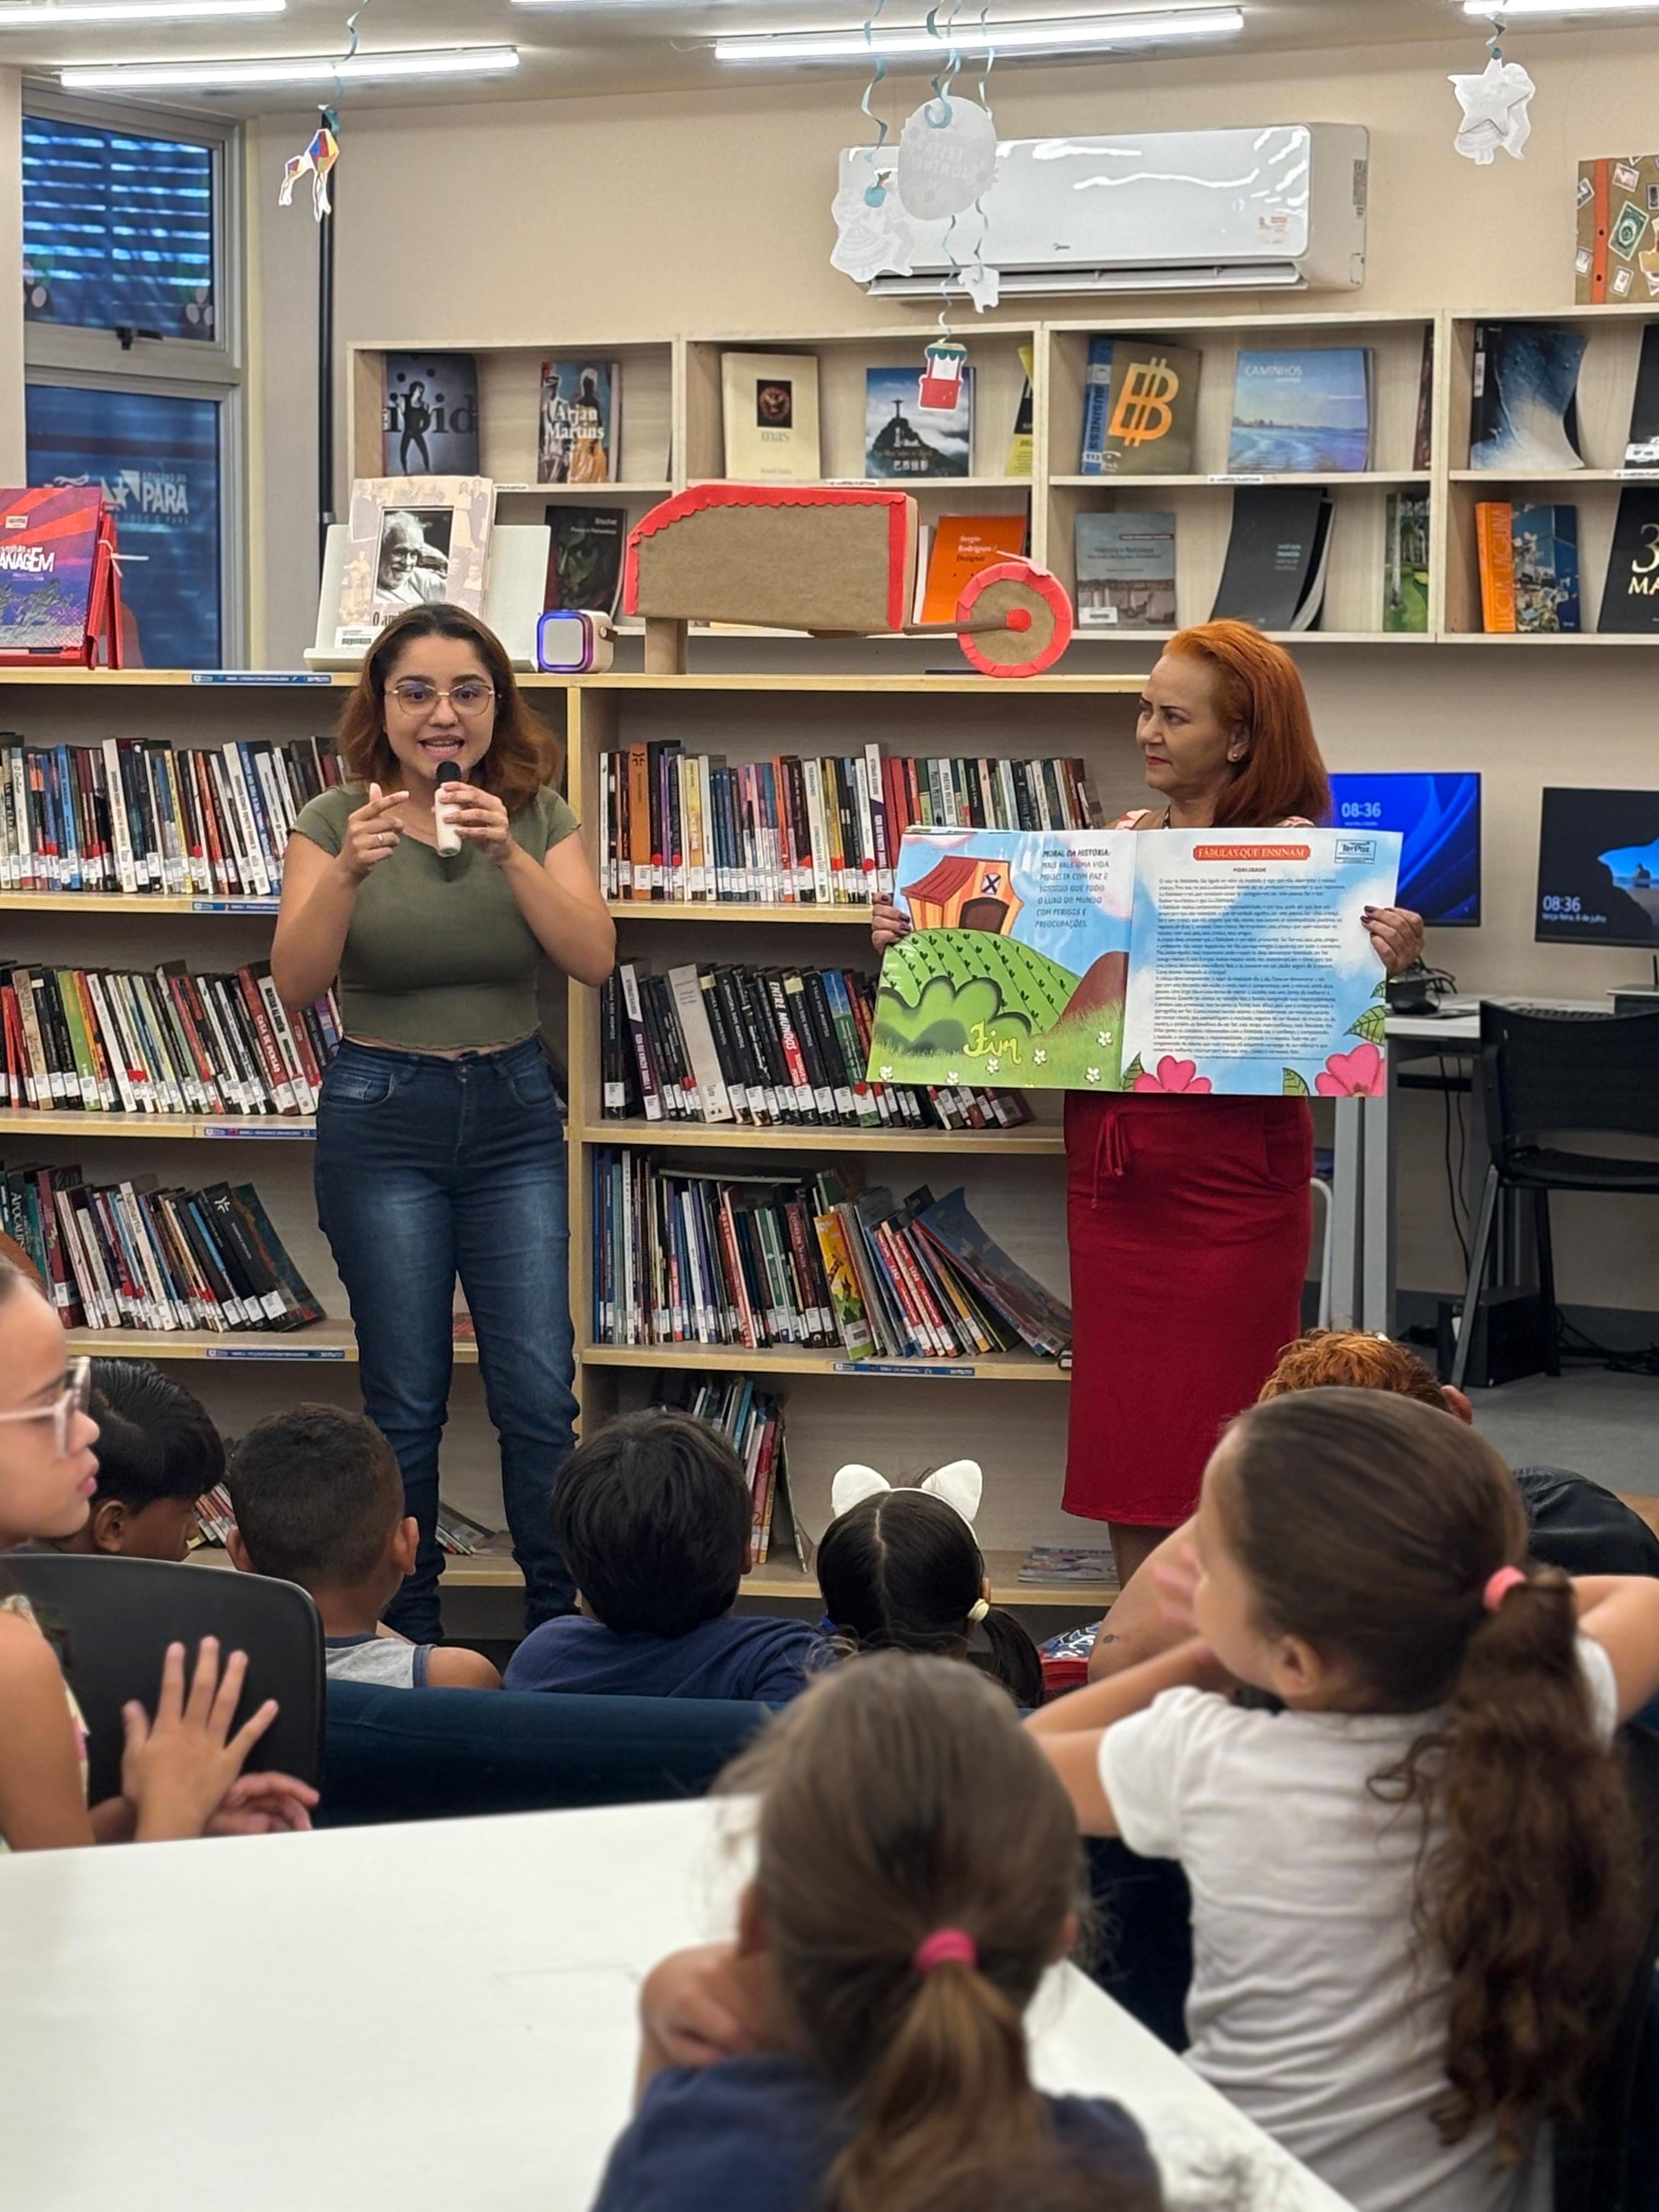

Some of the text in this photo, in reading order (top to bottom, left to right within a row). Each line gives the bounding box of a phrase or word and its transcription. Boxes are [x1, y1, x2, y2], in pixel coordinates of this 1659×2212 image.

[1245, 365, 1302, 376] CAMINHOS
[554, 403, 597, 427] Arjan
[1090, 386, 1105, 449] BUSINESS
[549, 422, 605, 439] Martins
[1341, 802, 1381, 817] 08:36
[1239, 848, 1259, 859] QUE
[1542, 895, 1581, 912] 08:36
[768, 979, 798, 1052] ENTRE MUNDOS
[262, 1034, 271, 1045] DE
[963, 1020, 1022, 1065] Fim
